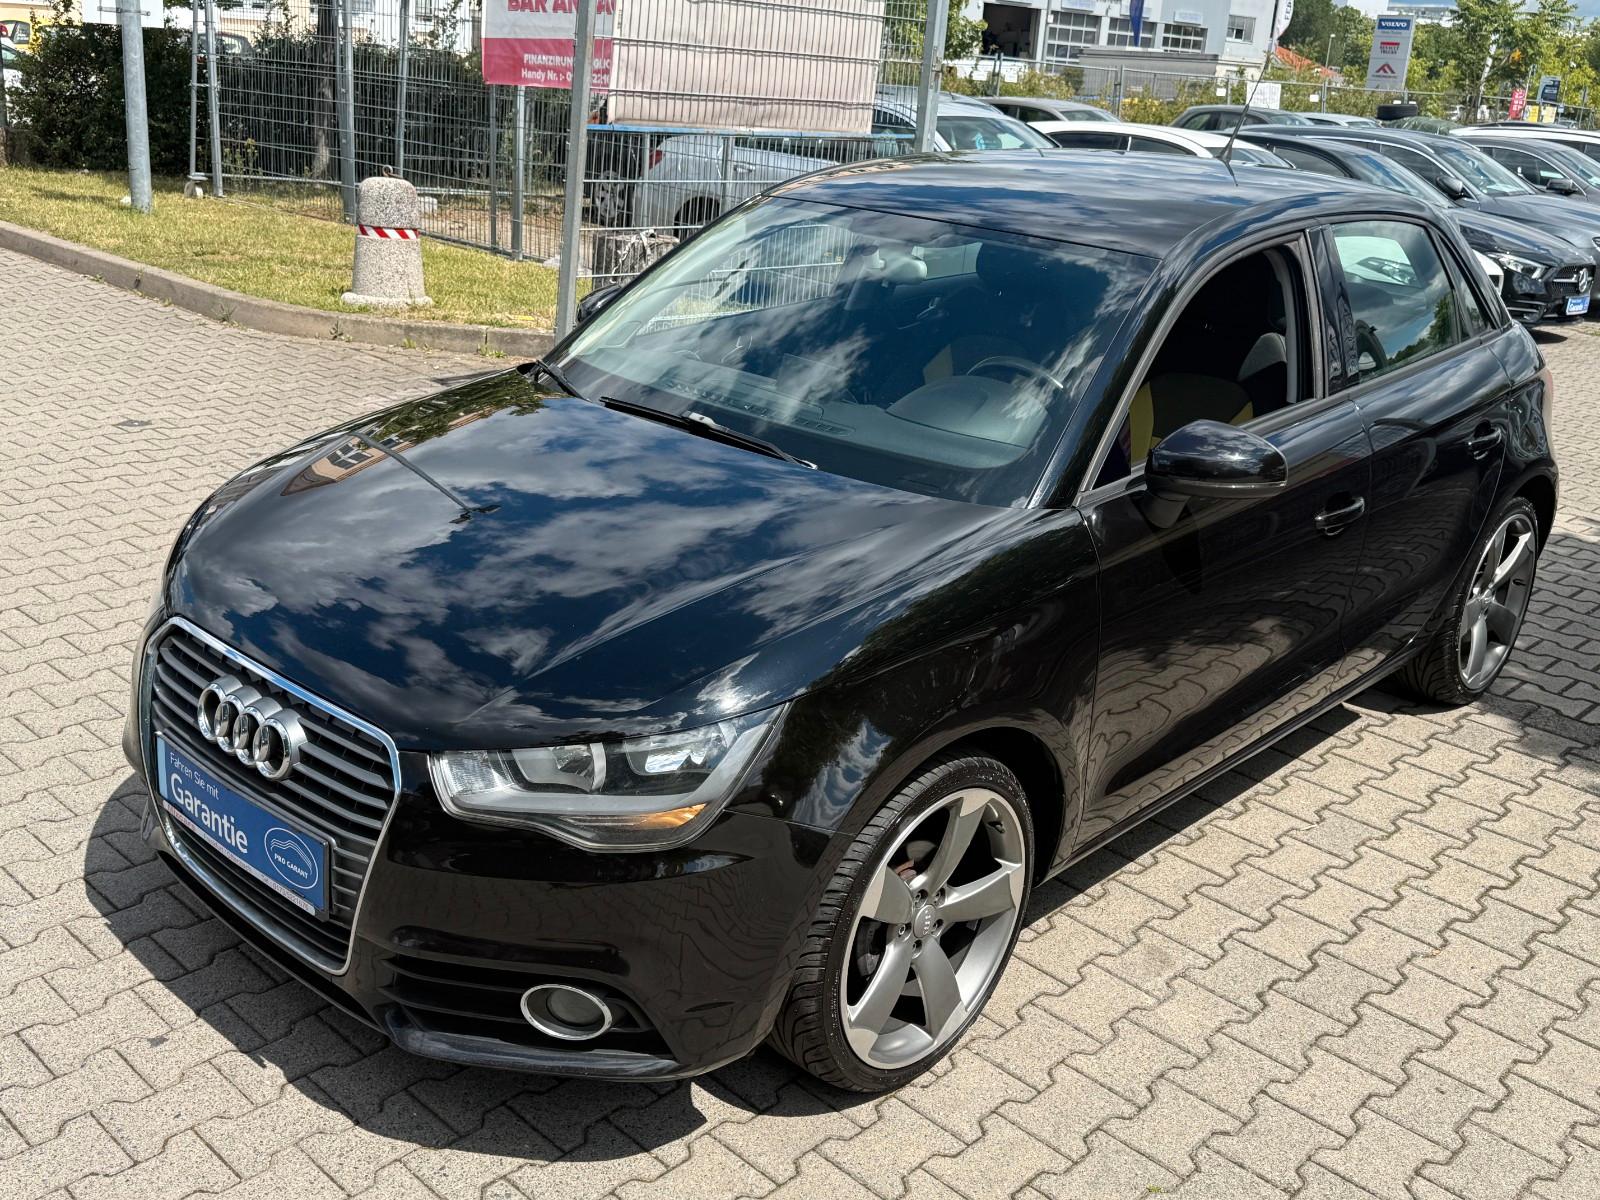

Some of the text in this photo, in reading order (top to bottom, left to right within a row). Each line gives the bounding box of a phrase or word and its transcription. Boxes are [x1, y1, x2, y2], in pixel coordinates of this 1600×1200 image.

[524, 54, 574, 66] FINANZIRUN
[522, 69, 545, 81] Handy
[547, 70, 558, 81] Nr.
[170, 752, 220, 800] Fahren Sie mit
[170, 773, 249, 854] Garantie
[274, 853, 309, 880] PRO GARANT
